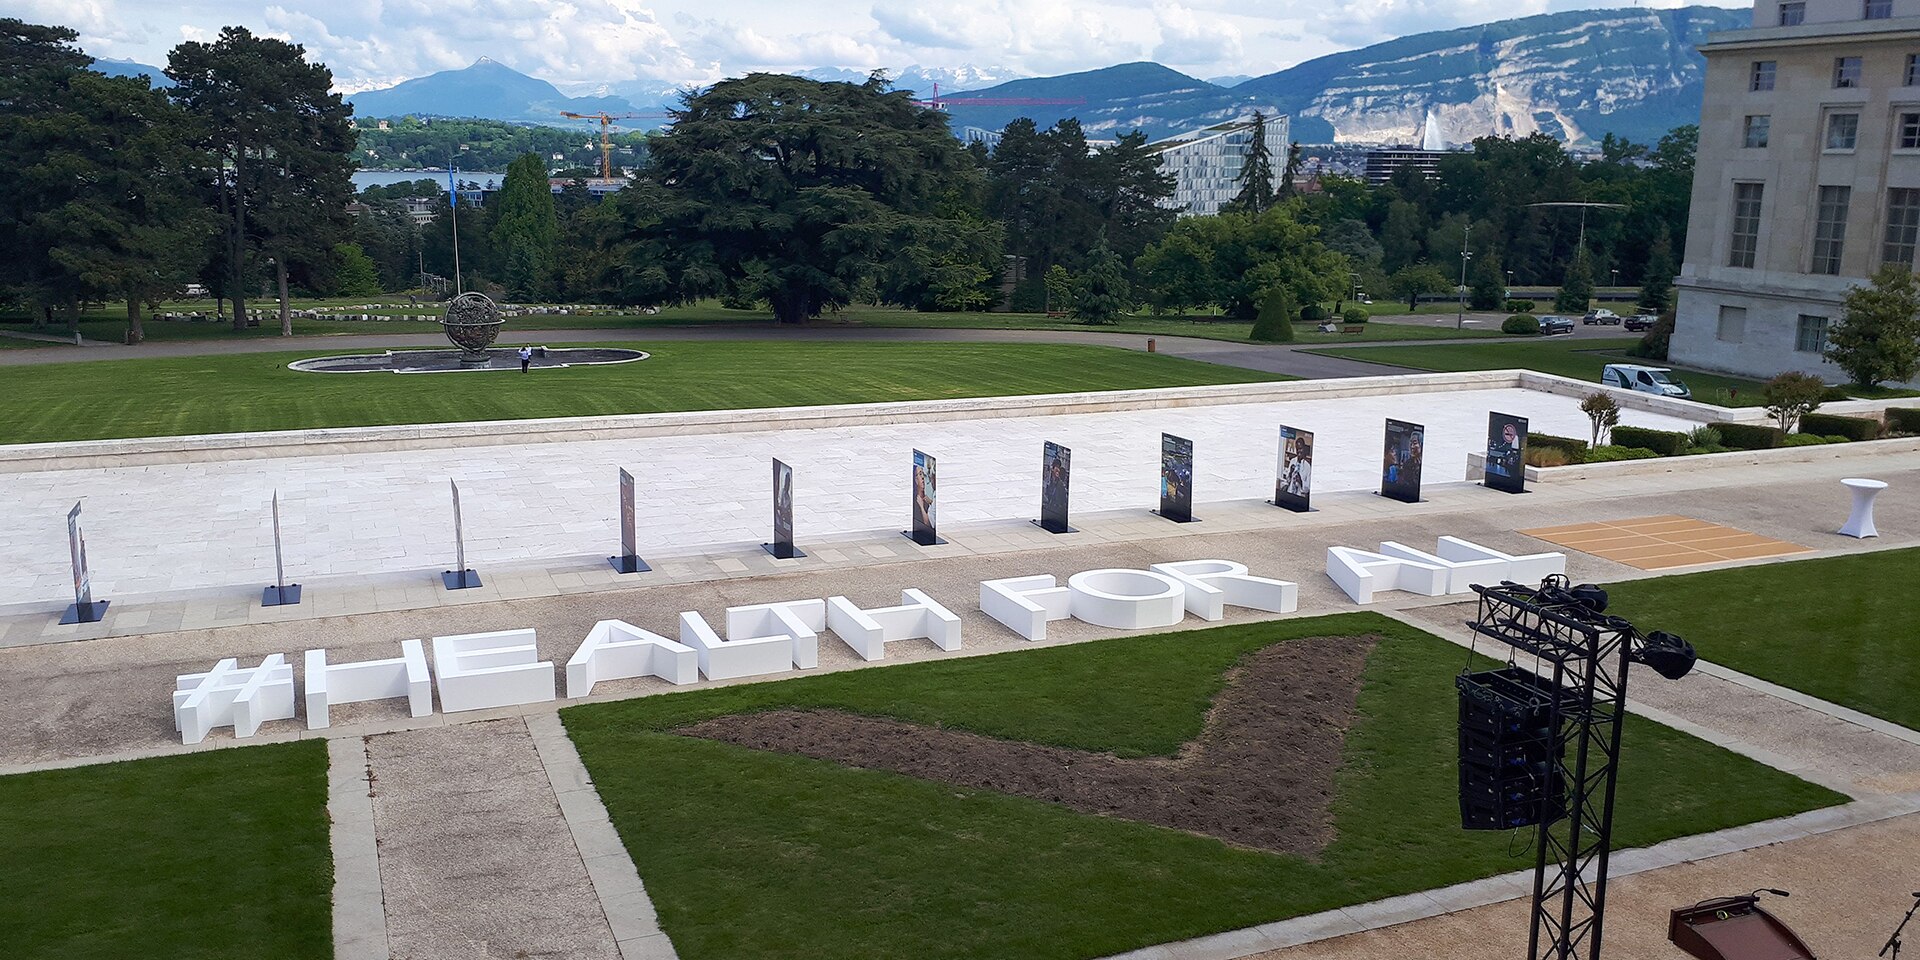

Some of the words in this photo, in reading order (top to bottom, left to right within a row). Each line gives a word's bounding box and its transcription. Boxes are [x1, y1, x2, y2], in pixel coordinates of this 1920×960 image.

[174, 588, 962, 744] #HEALTH
[980, 559, 1297, 641] FOR
[1327, 535, 1566, 604] ALL
